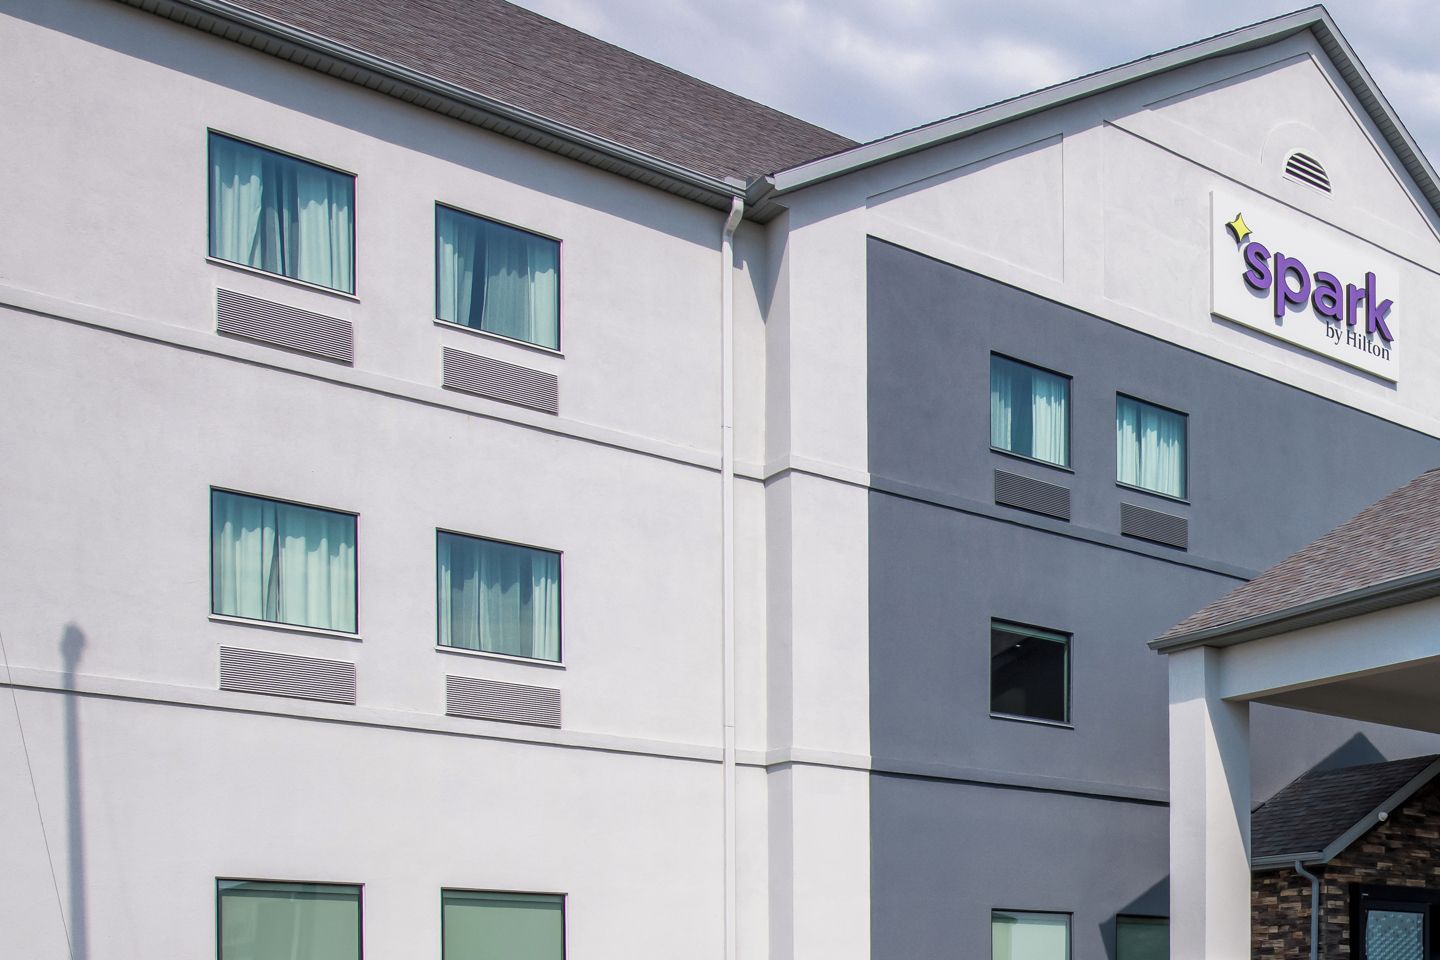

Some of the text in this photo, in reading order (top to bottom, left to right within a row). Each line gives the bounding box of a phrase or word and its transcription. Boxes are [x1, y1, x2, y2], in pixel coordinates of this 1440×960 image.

[1242, 242, 1395, 342] spark
[1326, 321, 1390, 361] by Hilton
